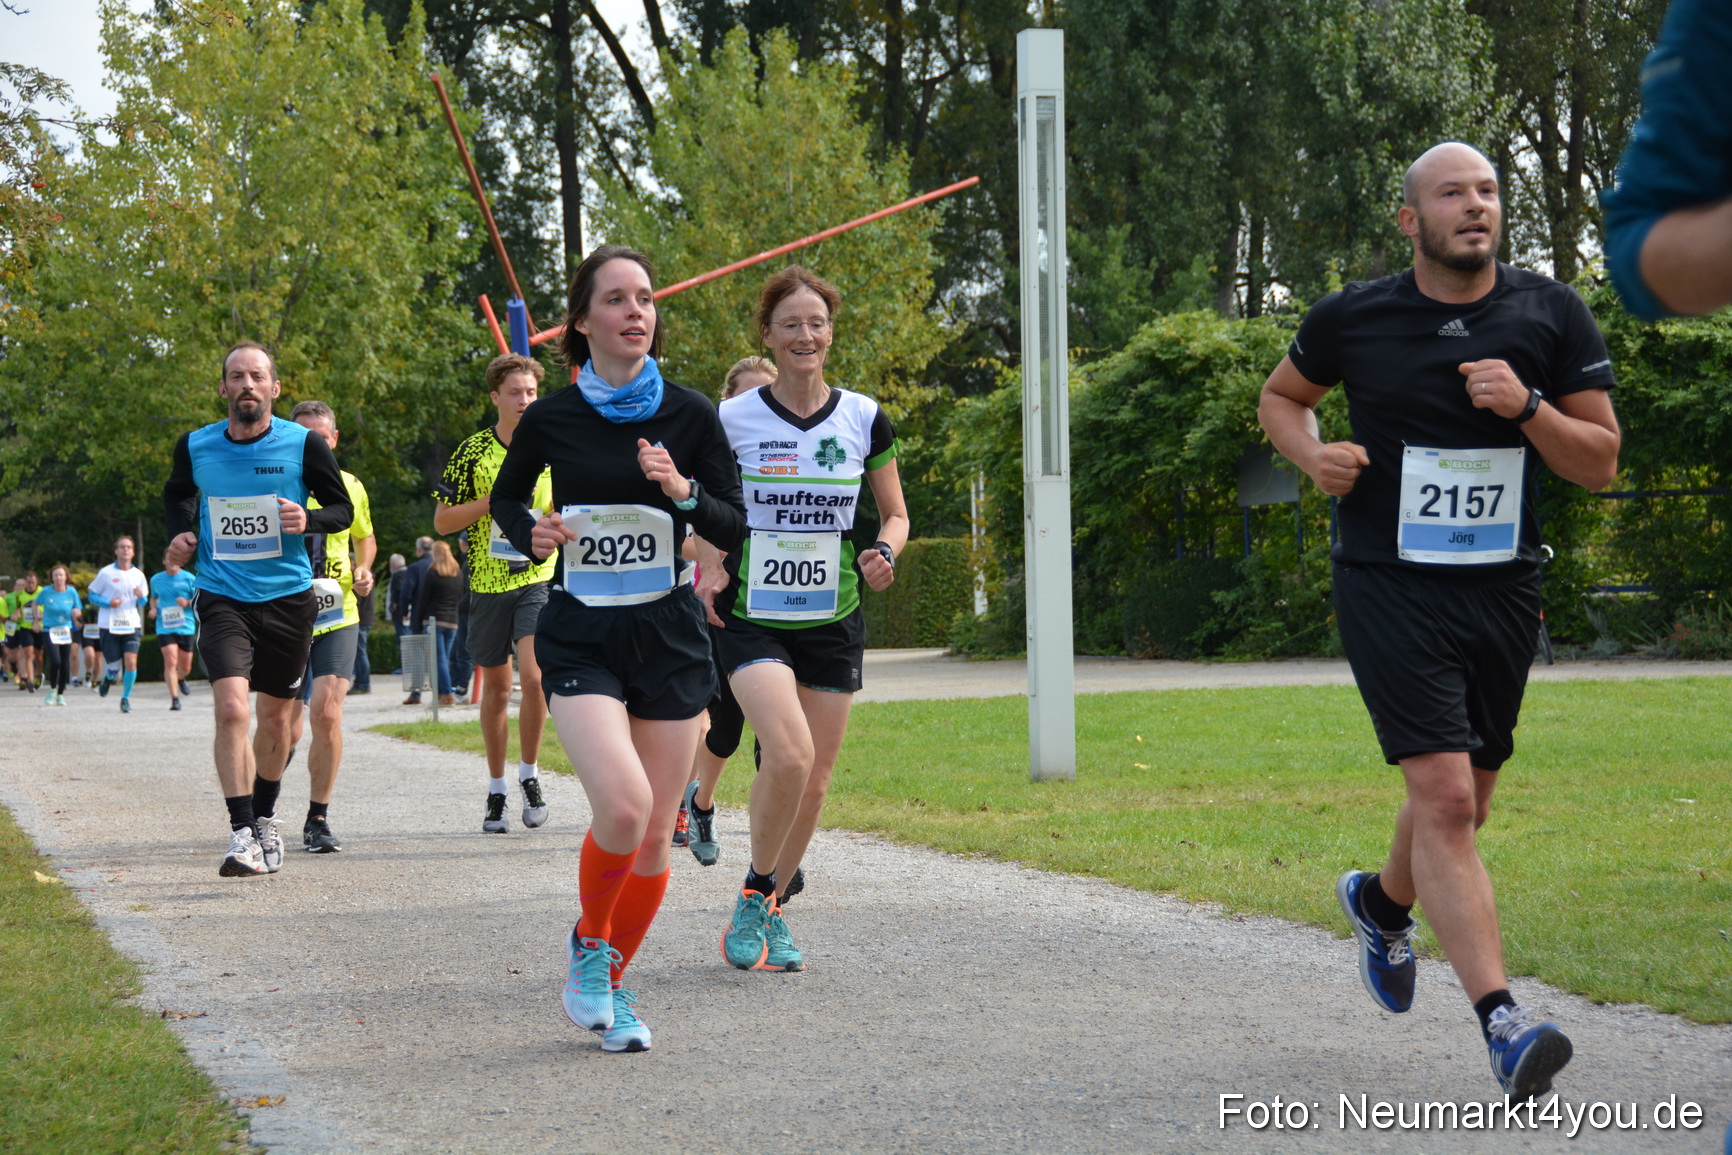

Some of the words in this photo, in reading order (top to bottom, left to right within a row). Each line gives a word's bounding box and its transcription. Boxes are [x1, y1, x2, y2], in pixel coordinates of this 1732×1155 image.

[1437, 329, 1470, 337] adidas
[759, 465, 799, 475] OBI
[1451, 459, 1491, 470] BOCK
[253, 466, 285, 475] THULE
[753, 489, 854, 507] Laufteam
[1418, 483, 1505, 519] 2157
[601, 513, 641, 523] BOCK
[775, 509, 835, 525] Fürth
[220, 515, 269, 536] 2653
[1448, 531, 1475, 545] Jörg
[235, 542, 257, 550] Marco
[579, 533, 657, 567] 2929
[786, 541, 817, 549] BOCK
[763, 559, 827, 587] 2005
[783, 595, 807, 606] Jutta
